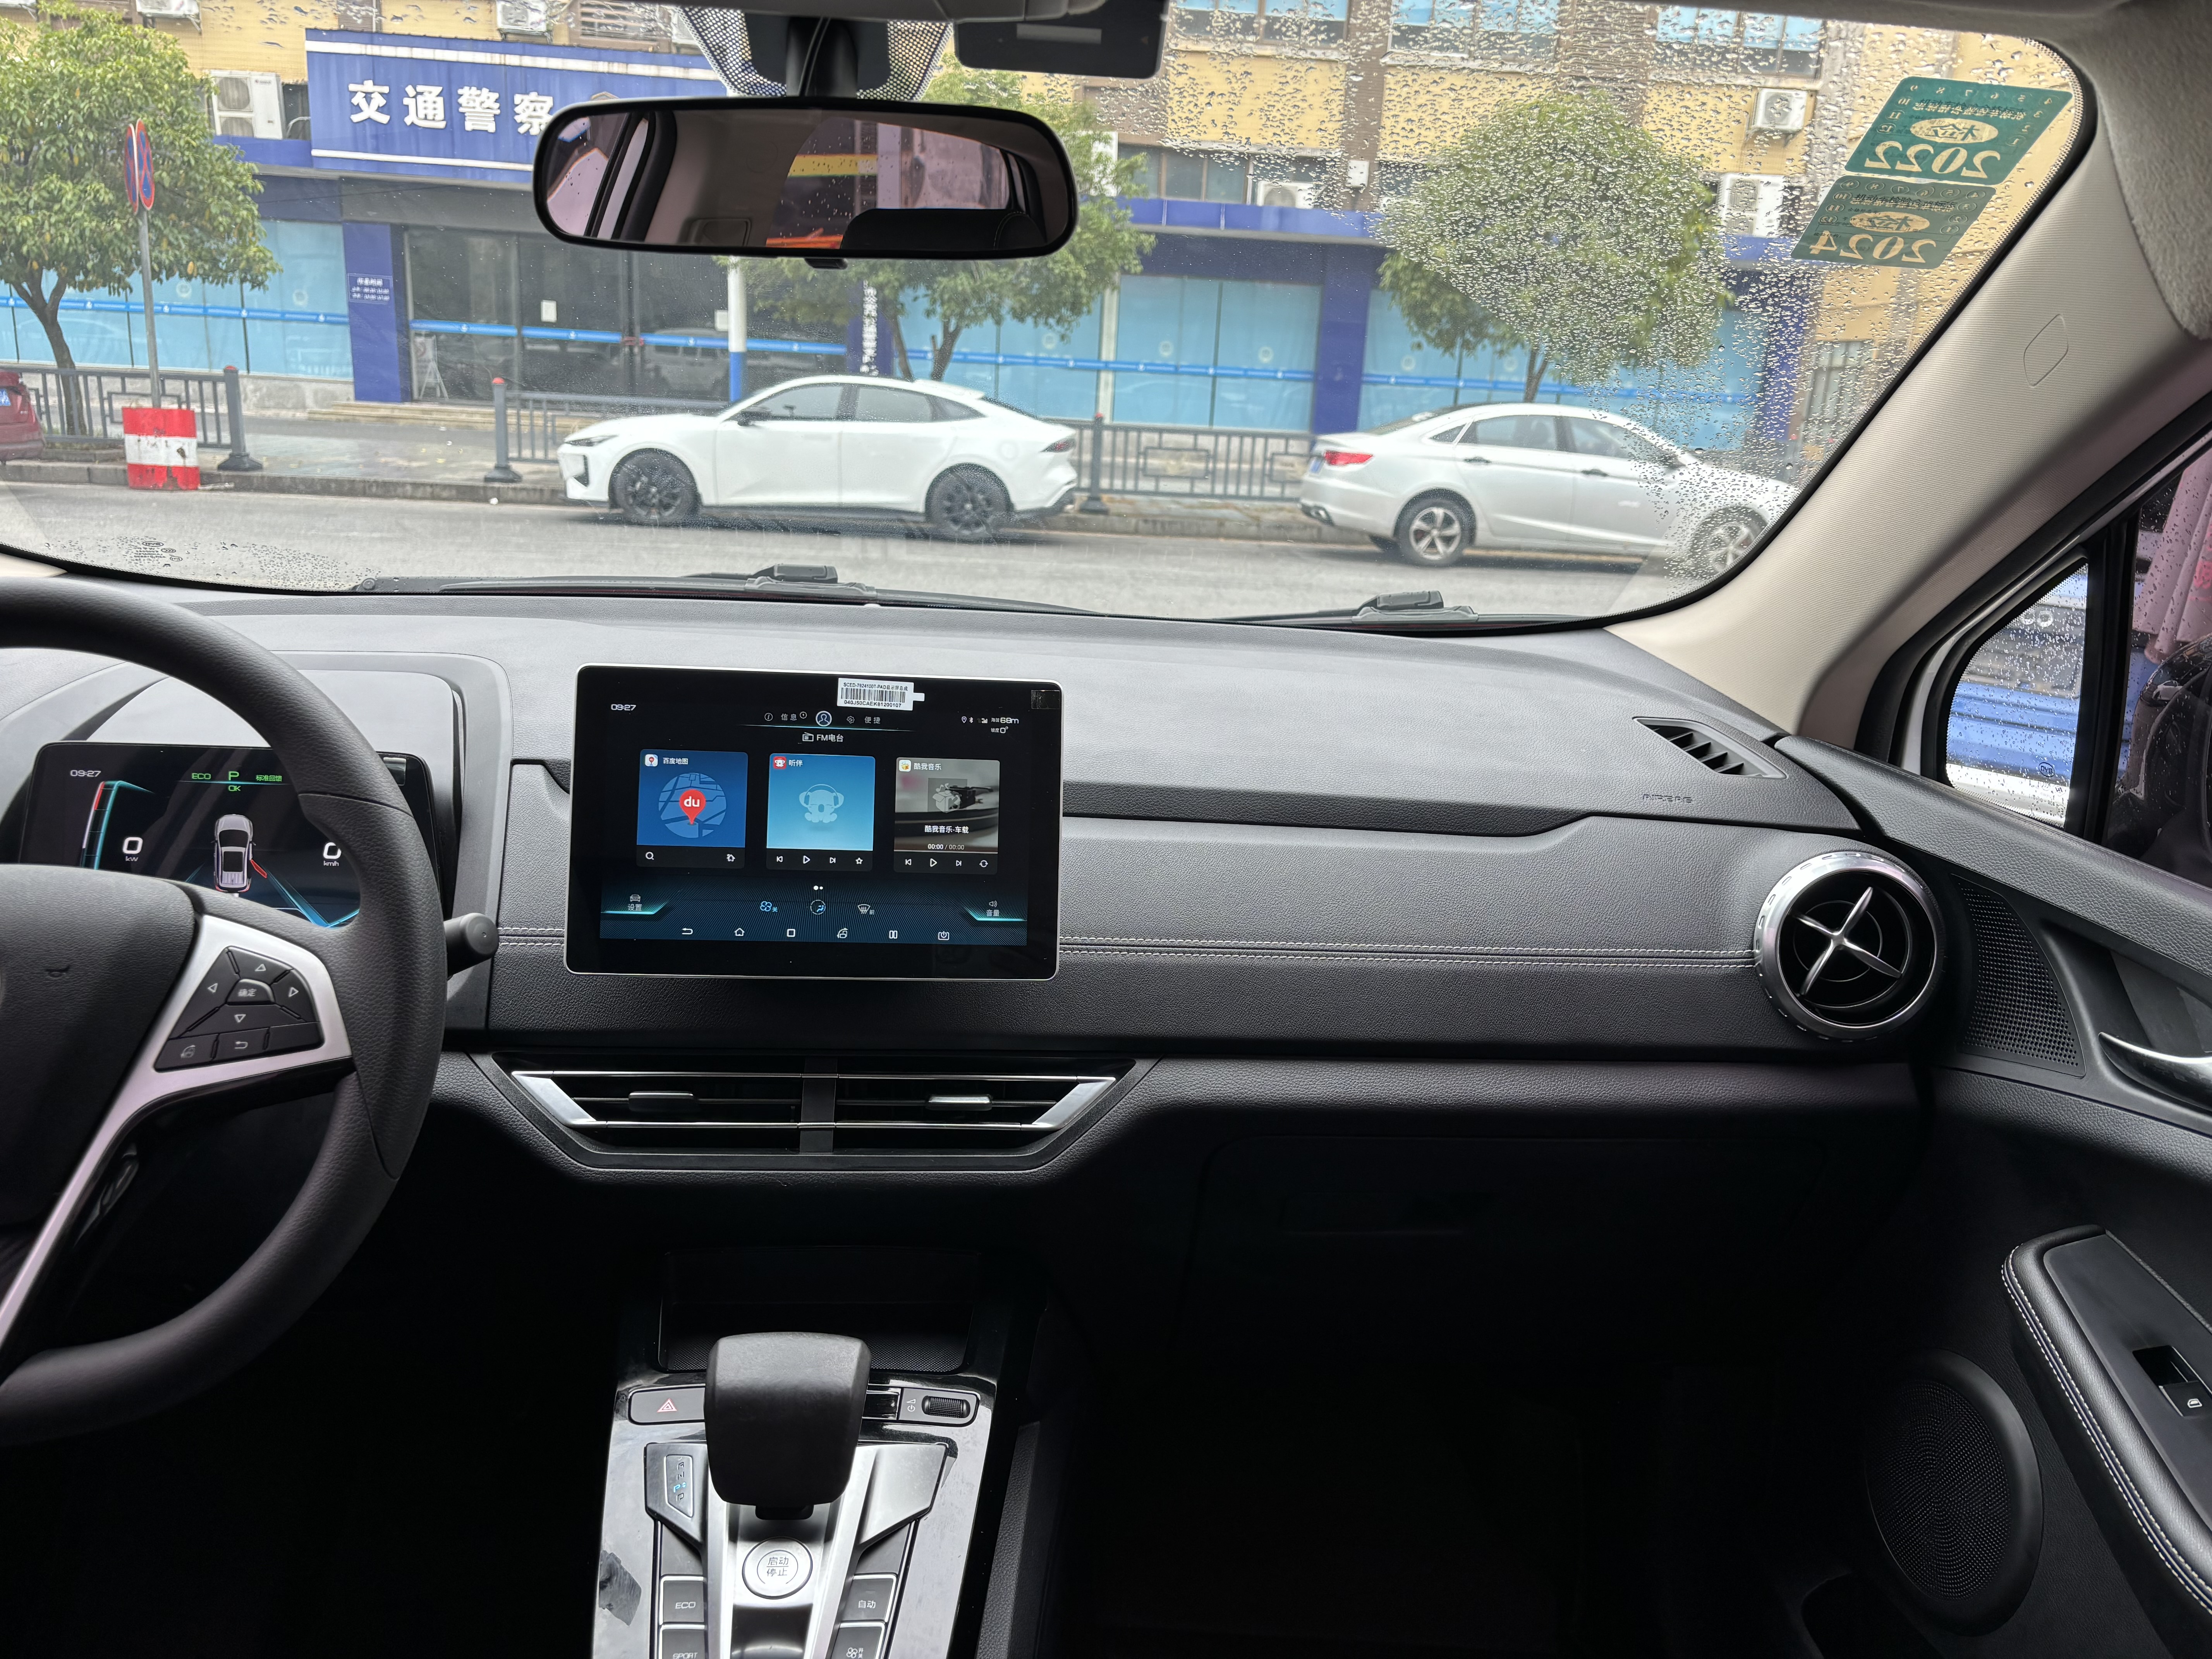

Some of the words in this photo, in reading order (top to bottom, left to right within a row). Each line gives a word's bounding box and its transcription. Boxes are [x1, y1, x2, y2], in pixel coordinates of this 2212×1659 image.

[348, 80, 553, 135] 交通警察
[228, 771, 239, 781] P
[684, 796, 700, 807] du
[924, 825, 969, 833] 酷我音乐-车载
[123, 837, 143, 854] 0
[323, 842, 342, 859] 0
[677, 1462, 684, 1470] R
[677, 1471, 684, 1480] N
[673, 1484, 681, 1493] P
[677, 1493, 684, 1502] D
[768, 1556, 789, 1565] 启动
[767, 1567, 787, 1577] 停止
